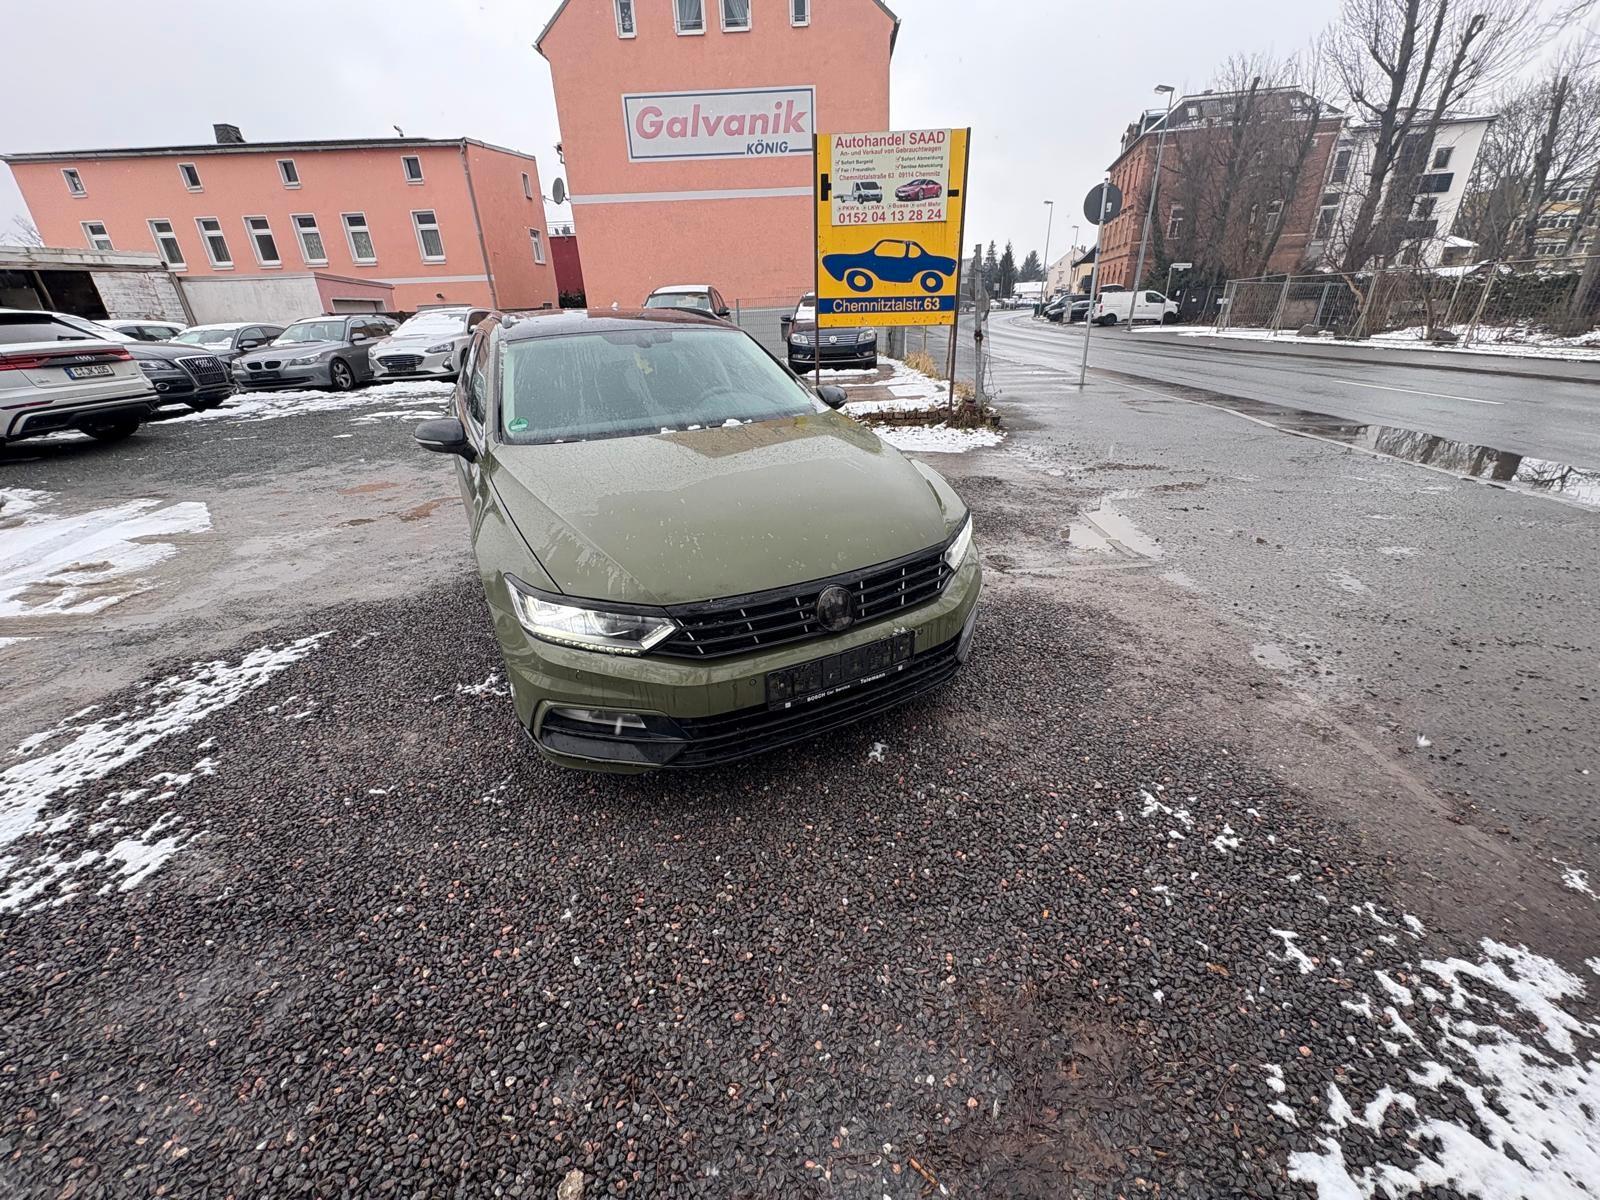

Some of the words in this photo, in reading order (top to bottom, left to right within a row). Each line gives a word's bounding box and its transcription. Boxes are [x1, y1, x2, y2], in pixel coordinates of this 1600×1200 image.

[635, 100, 807, 139] Galvanik
[746, 139, 788, 155] KÖNIG
[835, 133, 905, 149] Autohandel
[909, 131, 946, 145] SAAD
[839, 173, 887, 181] Chemnitztalstraße
[838, 212, 868, 224] 0152
[871, 211, 886, 223] 04
[890, 210, 905, 222] 13
[908, 209, 923, 221] 28
[927, 208, 942, 220] 24
